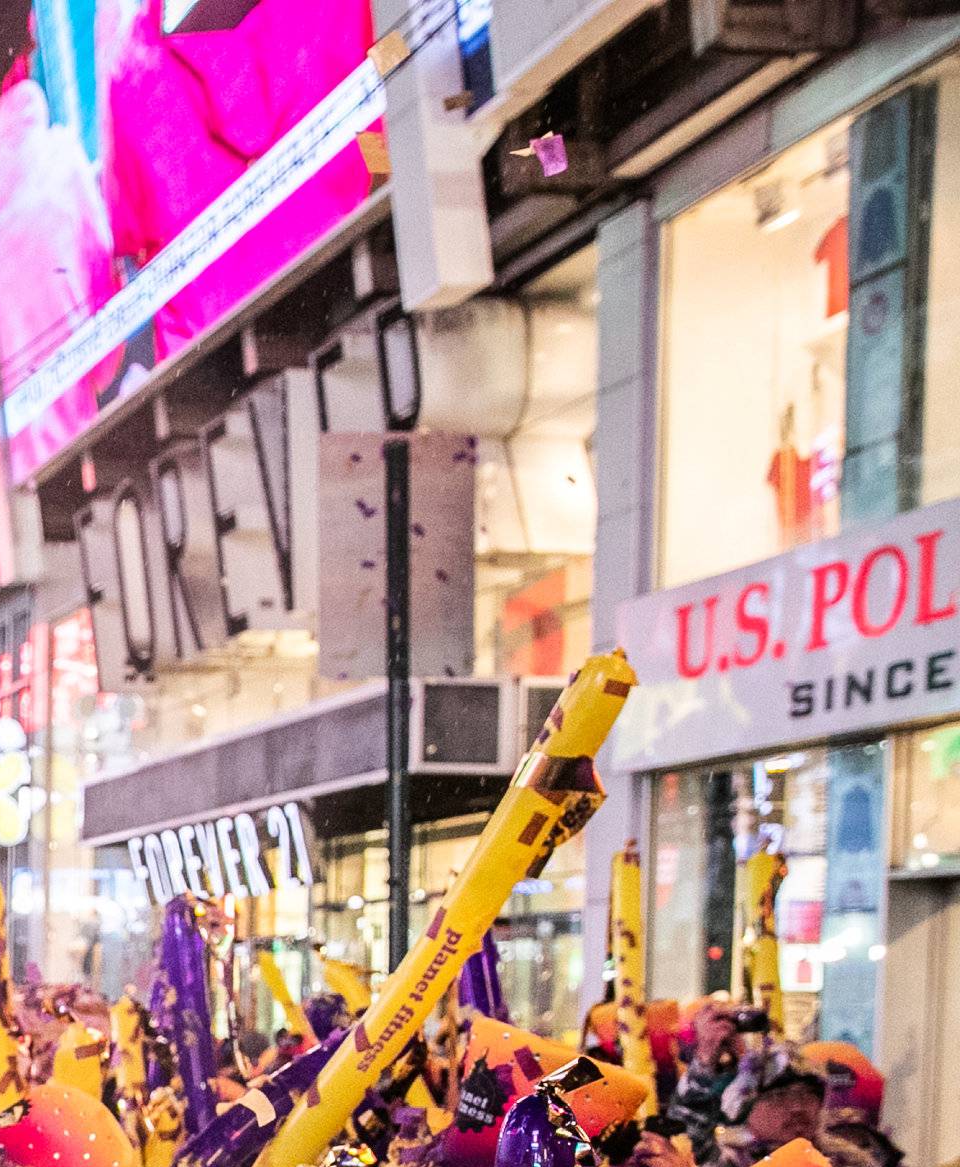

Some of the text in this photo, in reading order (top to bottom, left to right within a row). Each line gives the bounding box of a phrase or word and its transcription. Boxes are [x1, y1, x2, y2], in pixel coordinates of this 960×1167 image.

[675, 530, 959, 679] U.S. POL
[788, 650, 956, 718] SINCE
[128, 802, 313, 906] FOREVER 21
[357, 927, 463, 1072] planet fitness
